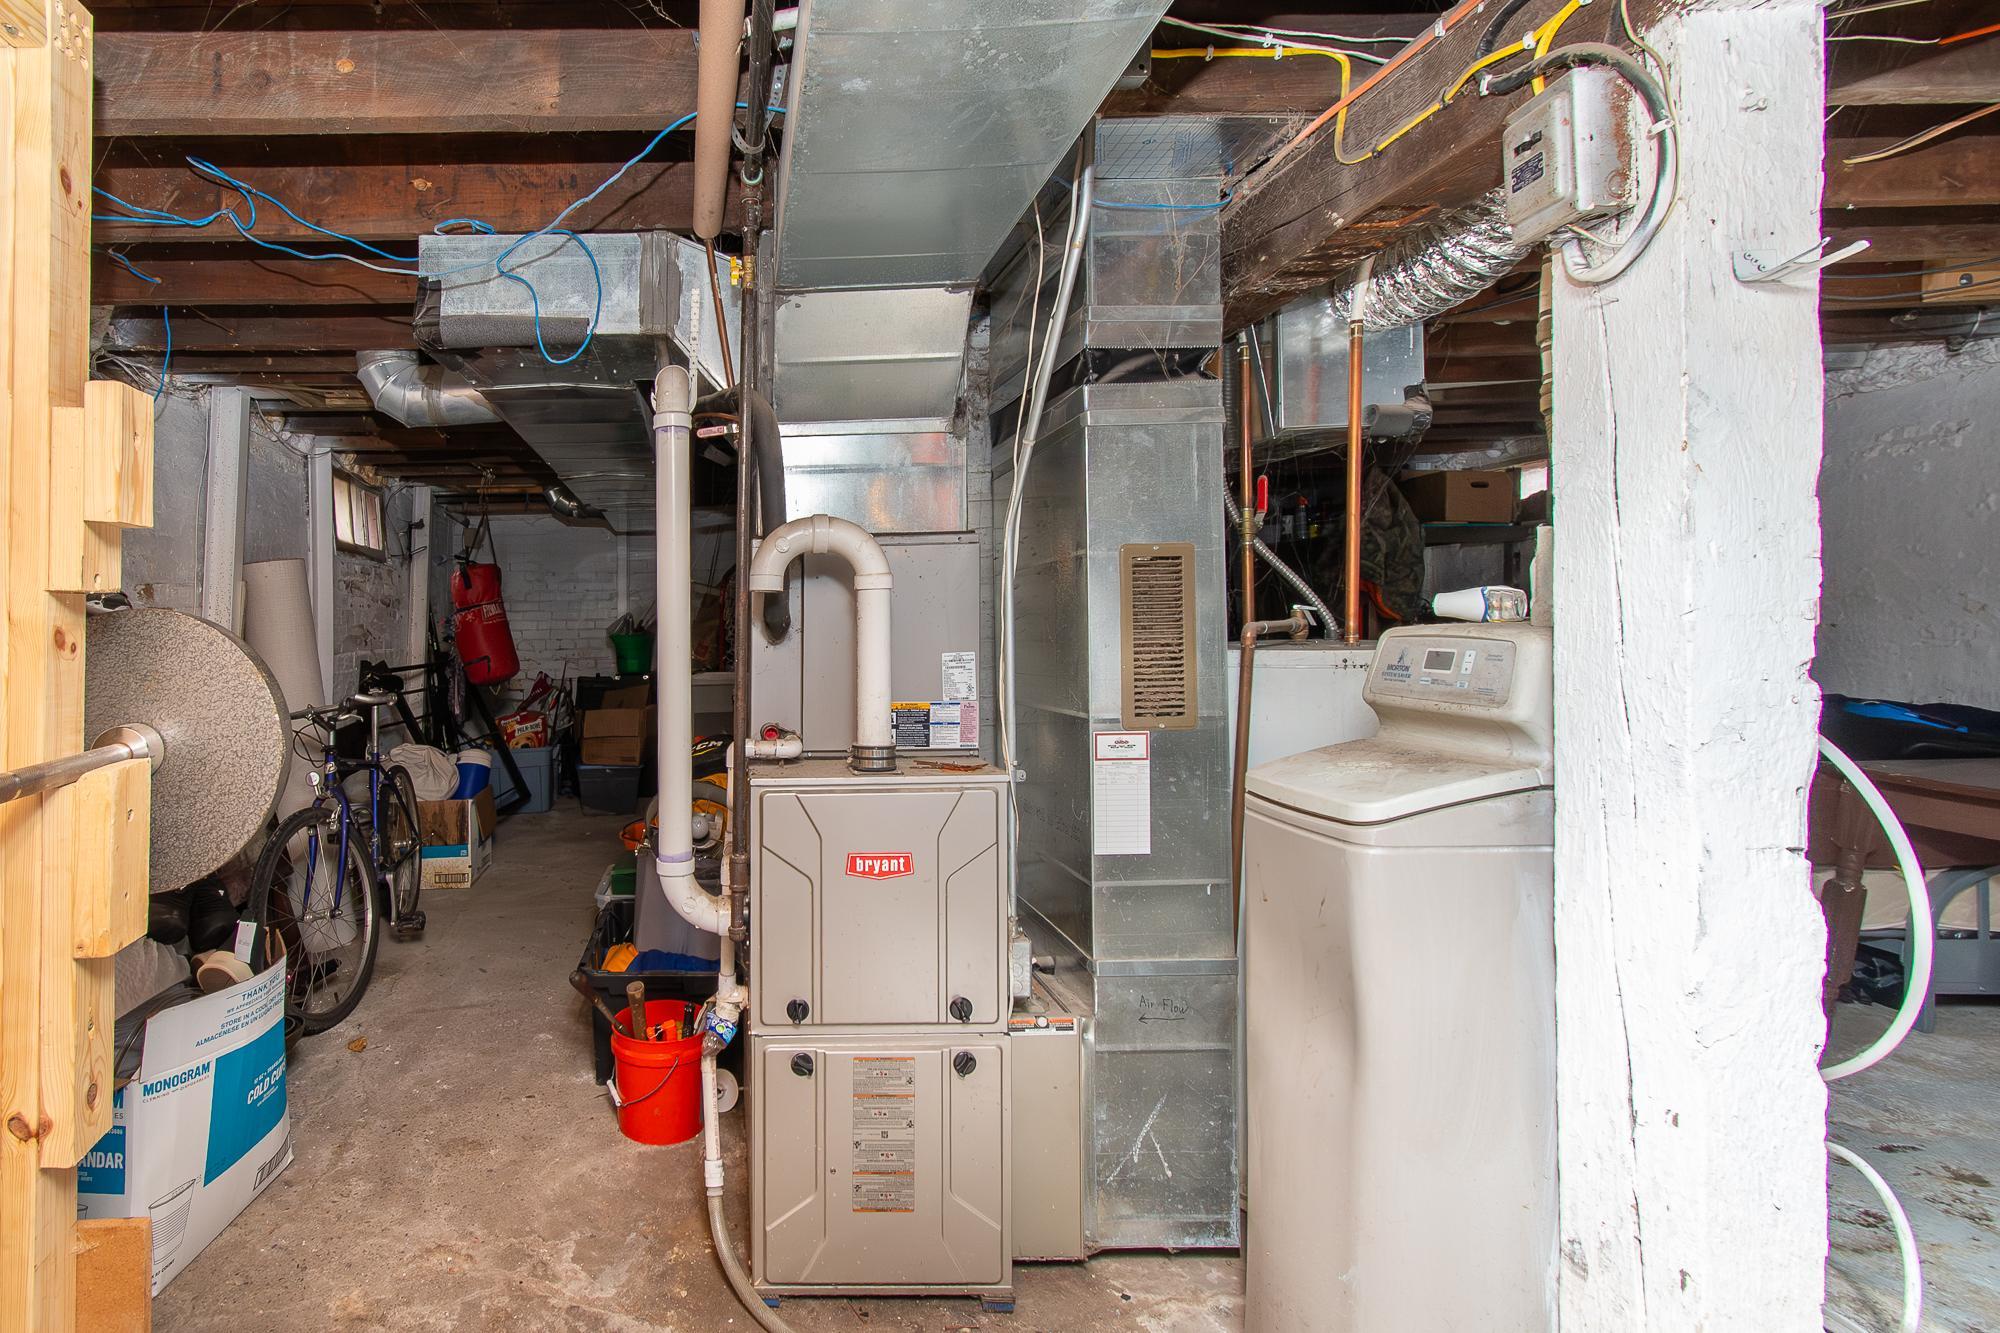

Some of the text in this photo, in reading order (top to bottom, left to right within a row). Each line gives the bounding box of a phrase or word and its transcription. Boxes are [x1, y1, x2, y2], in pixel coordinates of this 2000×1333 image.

[856, 857, 904, 874] bryant
[242, 983, 268, 1001] THANK
[1140, 995, 1189, 1014] Air Flow
[220, 1017, 241, 1029] STORE
[243, 1012, 250, 1021] IN
[241, 1018, 250, 1029] EN
[142, 1061, 211, 1097] MONOGRAM
[247, 1077, 270, 1104] COLD
